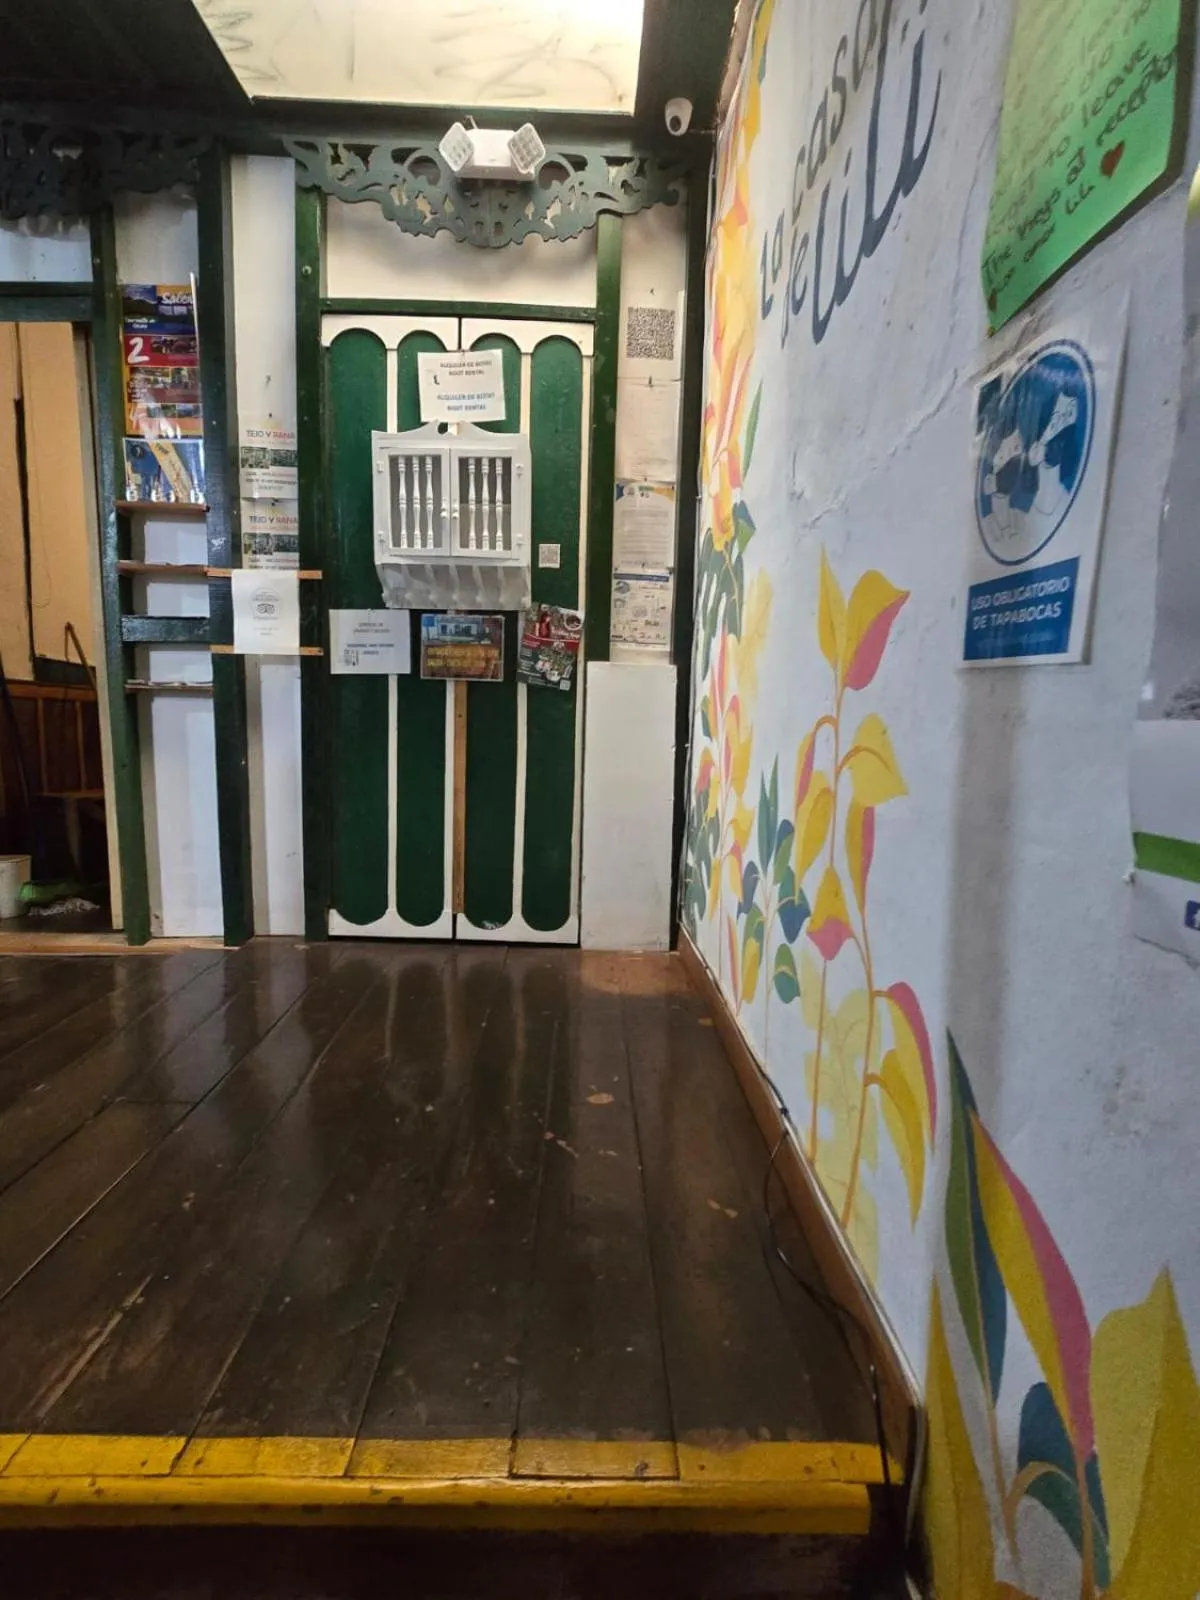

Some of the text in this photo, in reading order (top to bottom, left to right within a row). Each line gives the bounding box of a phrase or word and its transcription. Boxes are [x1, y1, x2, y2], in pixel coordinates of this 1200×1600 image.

[127, 336, 150, 364] 2
[246, 430, 265, 438] TEJO
[972, 576, 1071, 611] USO OBLIGATORIO
[973, 601, 1062, 631] DE TAPABOCAS
